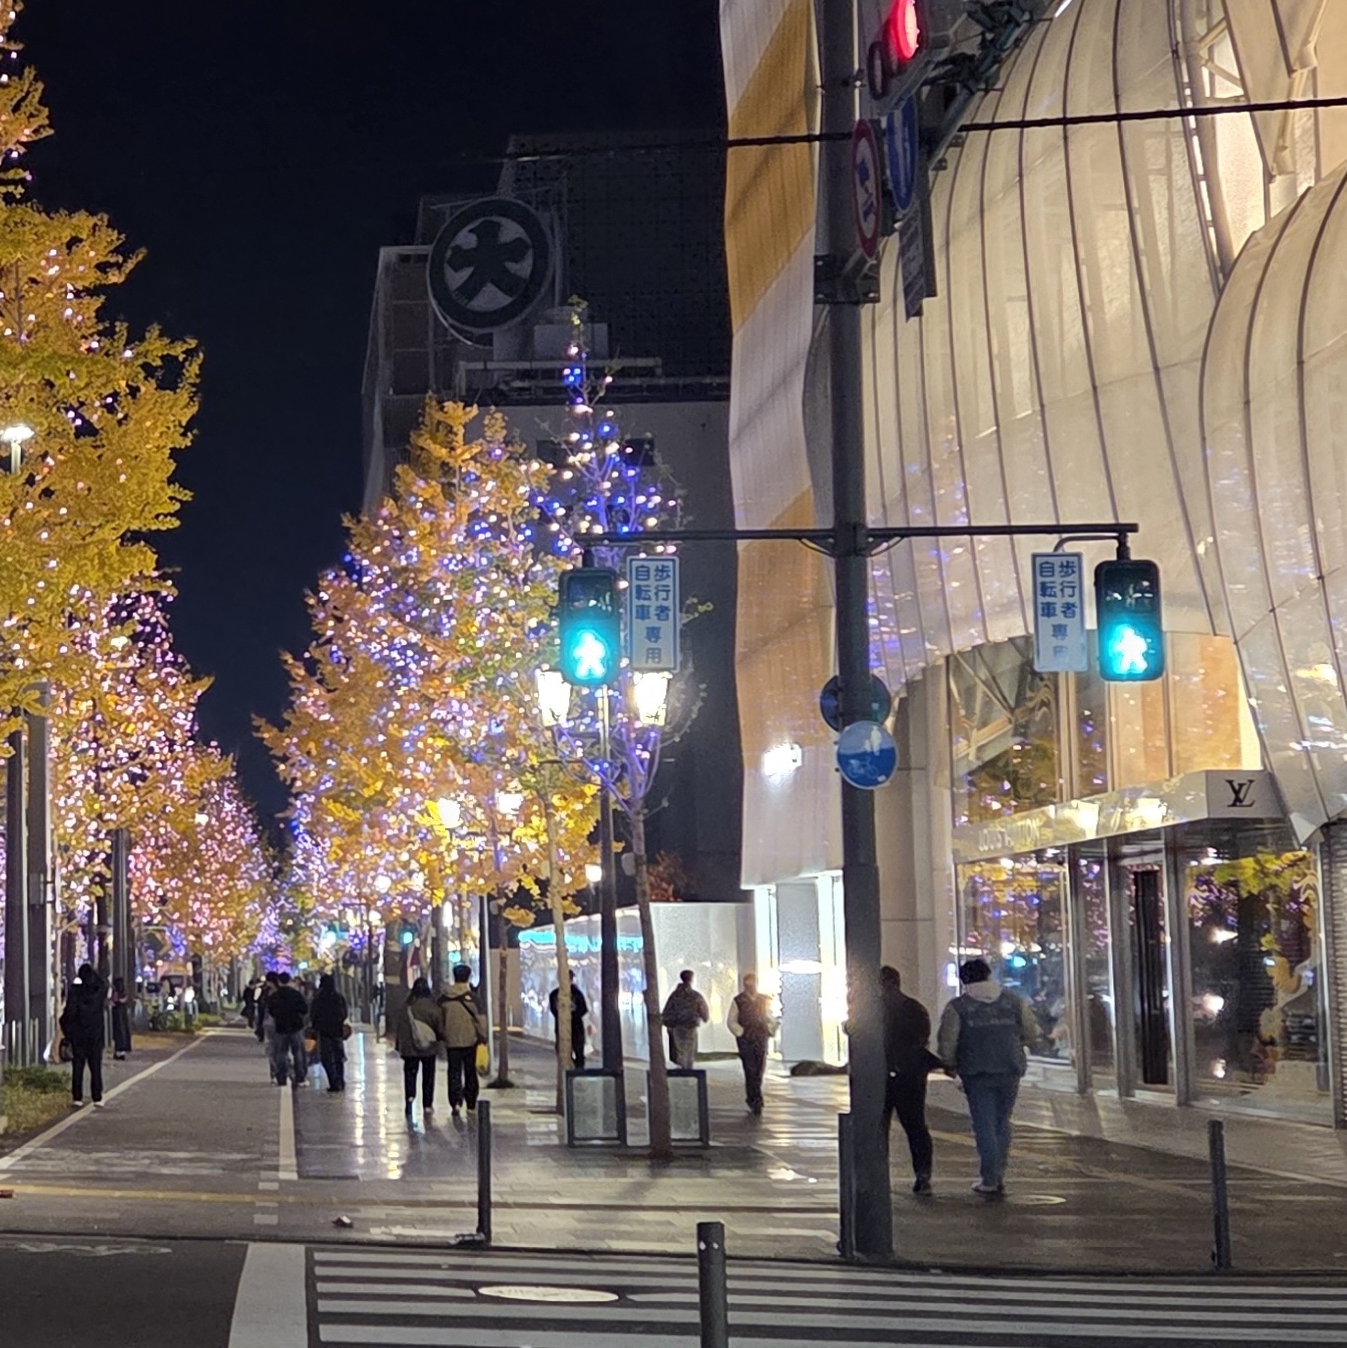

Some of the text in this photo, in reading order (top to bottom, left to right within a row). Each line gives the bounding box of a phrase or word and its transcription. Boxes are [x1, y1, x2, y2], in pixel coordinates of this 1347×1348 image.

[635, 565, 651, 621] 自転車
[654, 565, 671, 622] 歩行者
[1039, 561, 1057, 618] 自転車
[1058, 560, 1078, 619] 歩行者
[645, 626, 662, 664] 専用
